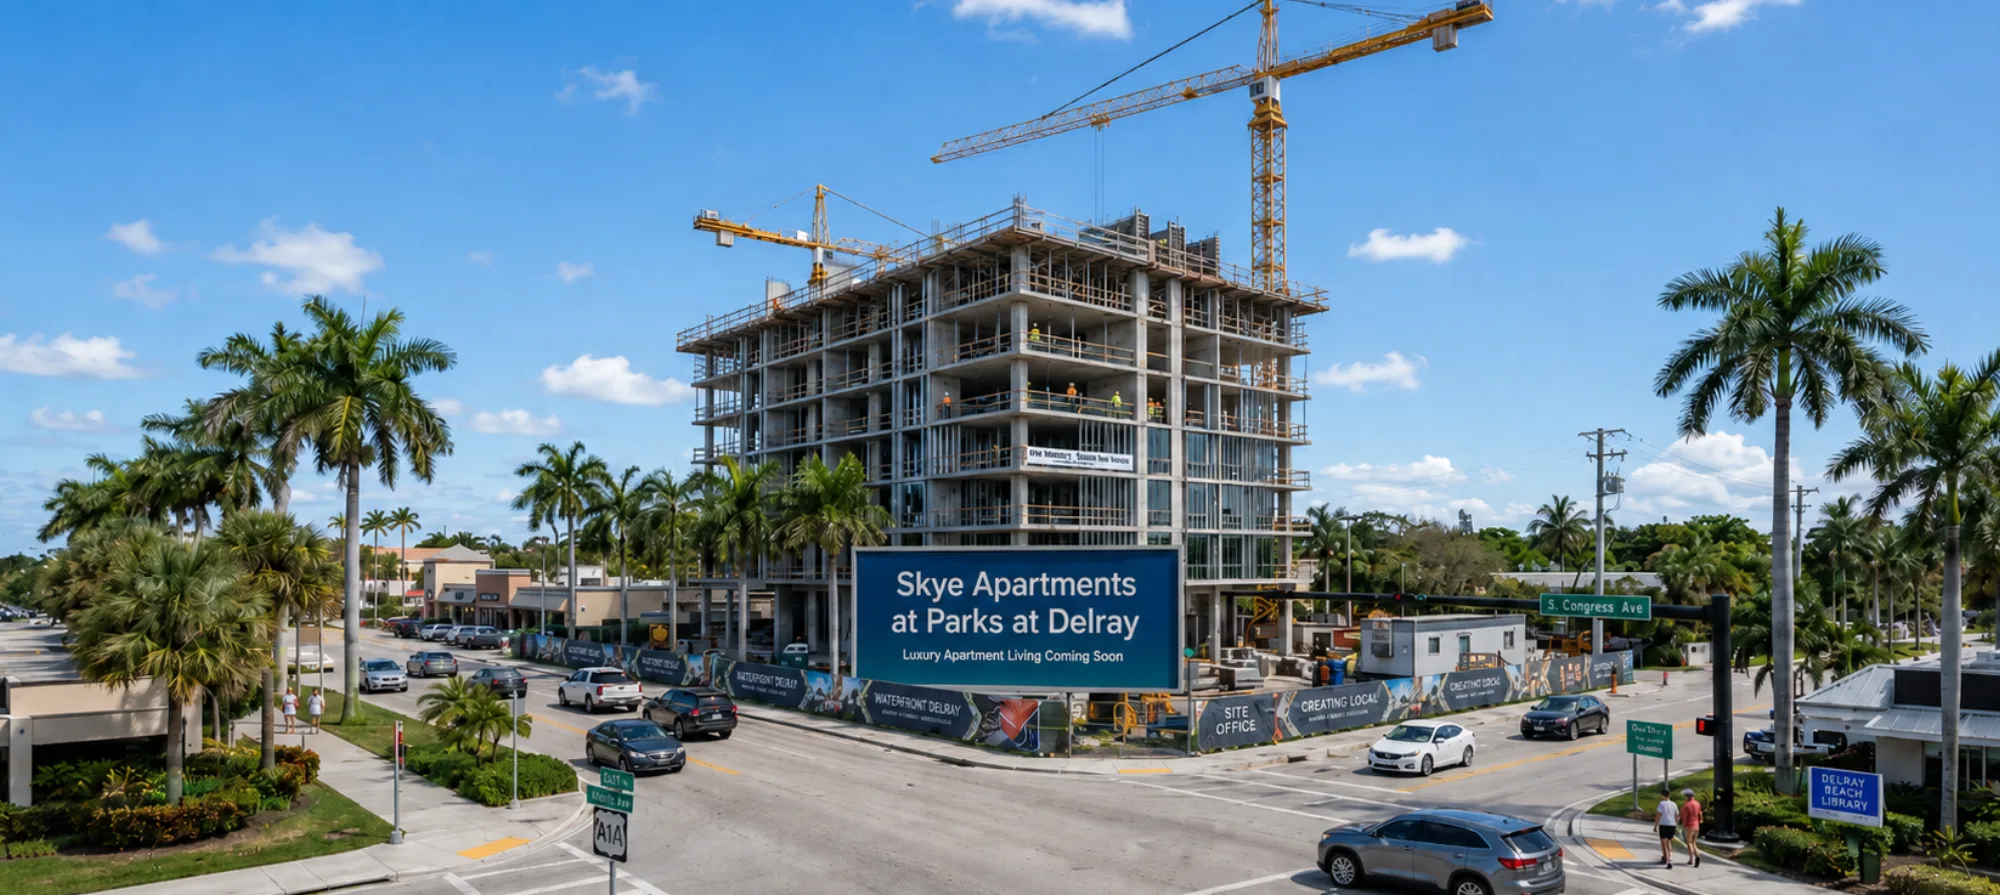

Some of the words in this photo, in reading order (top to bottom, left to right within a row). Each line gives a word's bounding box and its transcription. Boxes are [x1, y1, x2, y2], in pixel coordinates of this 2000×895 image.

[896, 570, 964, 602] Skye
[972, 570, 1137, 602] Apartments
[1548, 599, 1558, 611] S.
[1563, 599, 1614, 615] Congress
[1621, 601, 1644, 614] Ave
[891, 610, 918, 634] at
[927, 607, 1004, 634] Parks
[1012, 610, 1039, 634] at
[1048, 607, 1140, 640] Delray
[902, 648, 941, 663] Luxury
[944, 649, 1004, 662] Apartment
[1007, 649, 1041, 664] Living
[1044, 650, 1090, 664] Coming
[1093, 650, 1124, 662] Soon
[873, 692, 928, 710] WATERFRONT
[929, 700, 962, 717] DELRAY
[1300, 697, 1347, 713] CREATING
[1350, 692, 1378, 707] LOCAL
[1224, 705, 1249, 720] SITE
[1216, 719, 1256, 736] OFFICE
[1821, 773, 1865, 788] DELRAY
[1824, 785, 1863, 799] BEACH
[1821, 796, 1868, 811] LIBRARY
[597, 821, 623, 847] A1A
